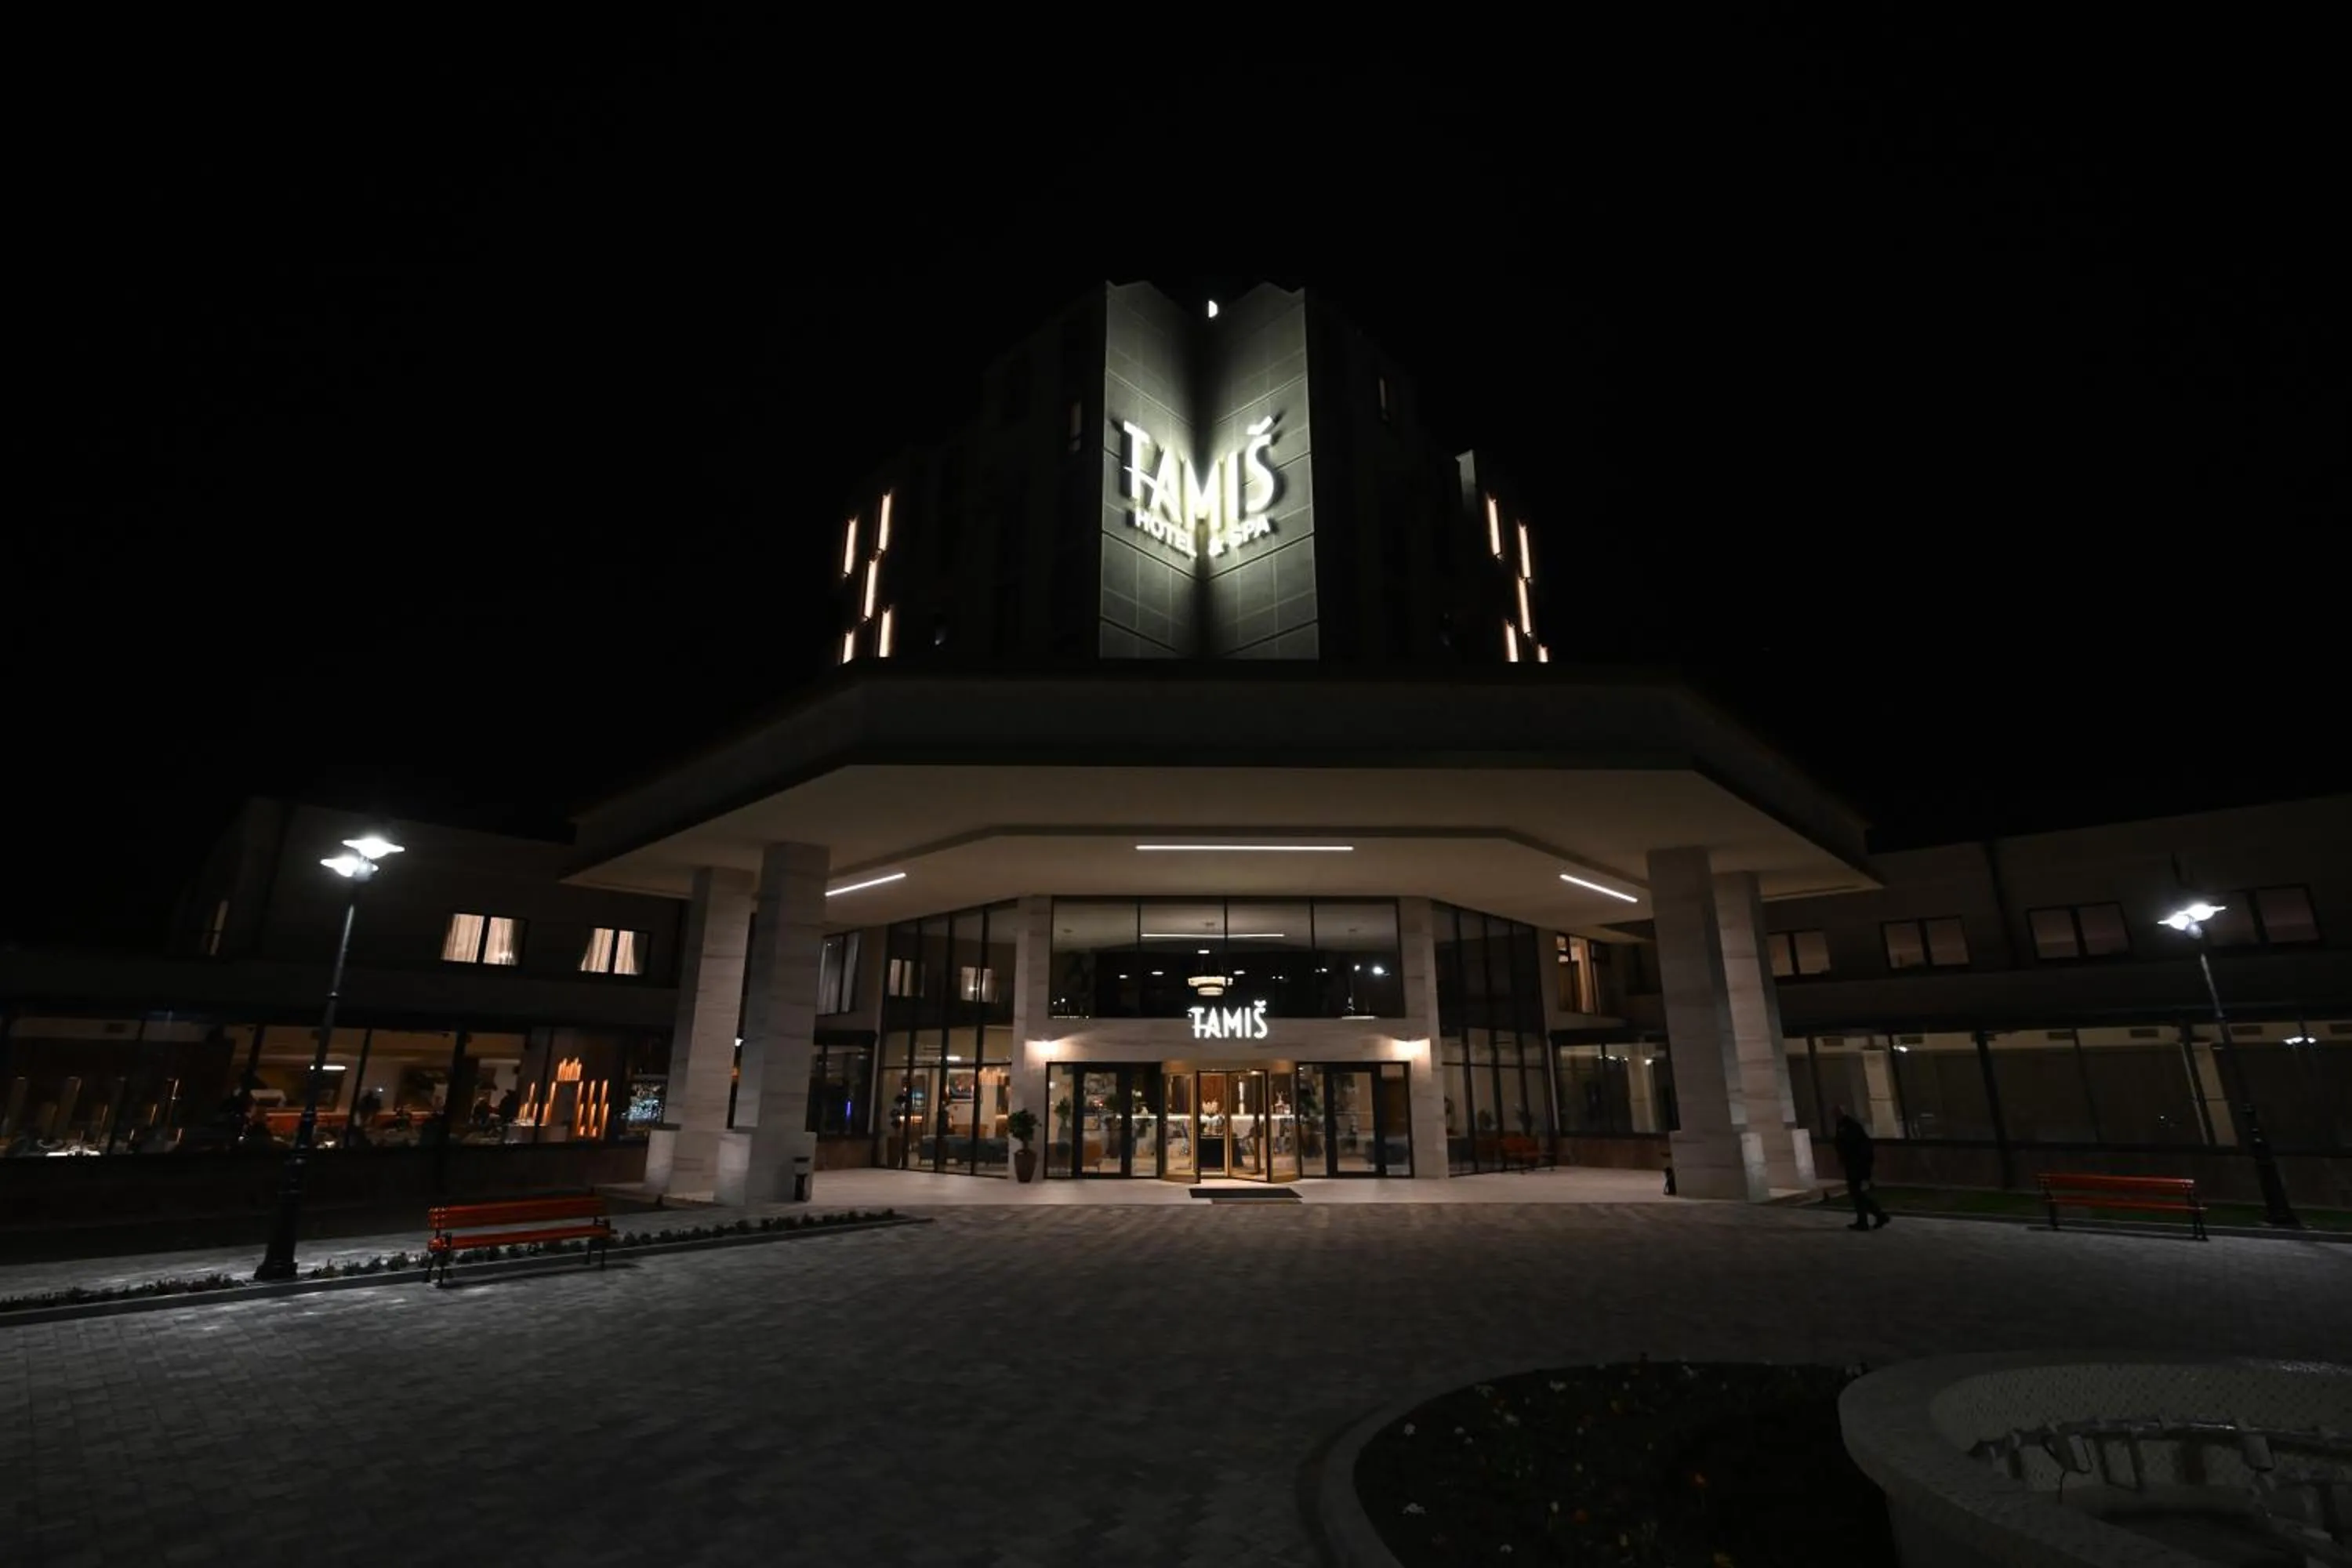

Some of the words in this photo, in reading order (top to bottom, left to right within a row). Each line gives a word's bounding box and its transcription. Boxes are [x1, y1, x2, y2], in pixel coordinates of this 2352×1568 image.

[1123, 416, 1274, 532] TAMIŠ
[1134, 508, 1197, 558] HOTEL
[1208, 537, 1224, 557] &
[1229, 513, 1270, 550] SPA
[1190, 1000, 1268, 1039] TAMIŠ
